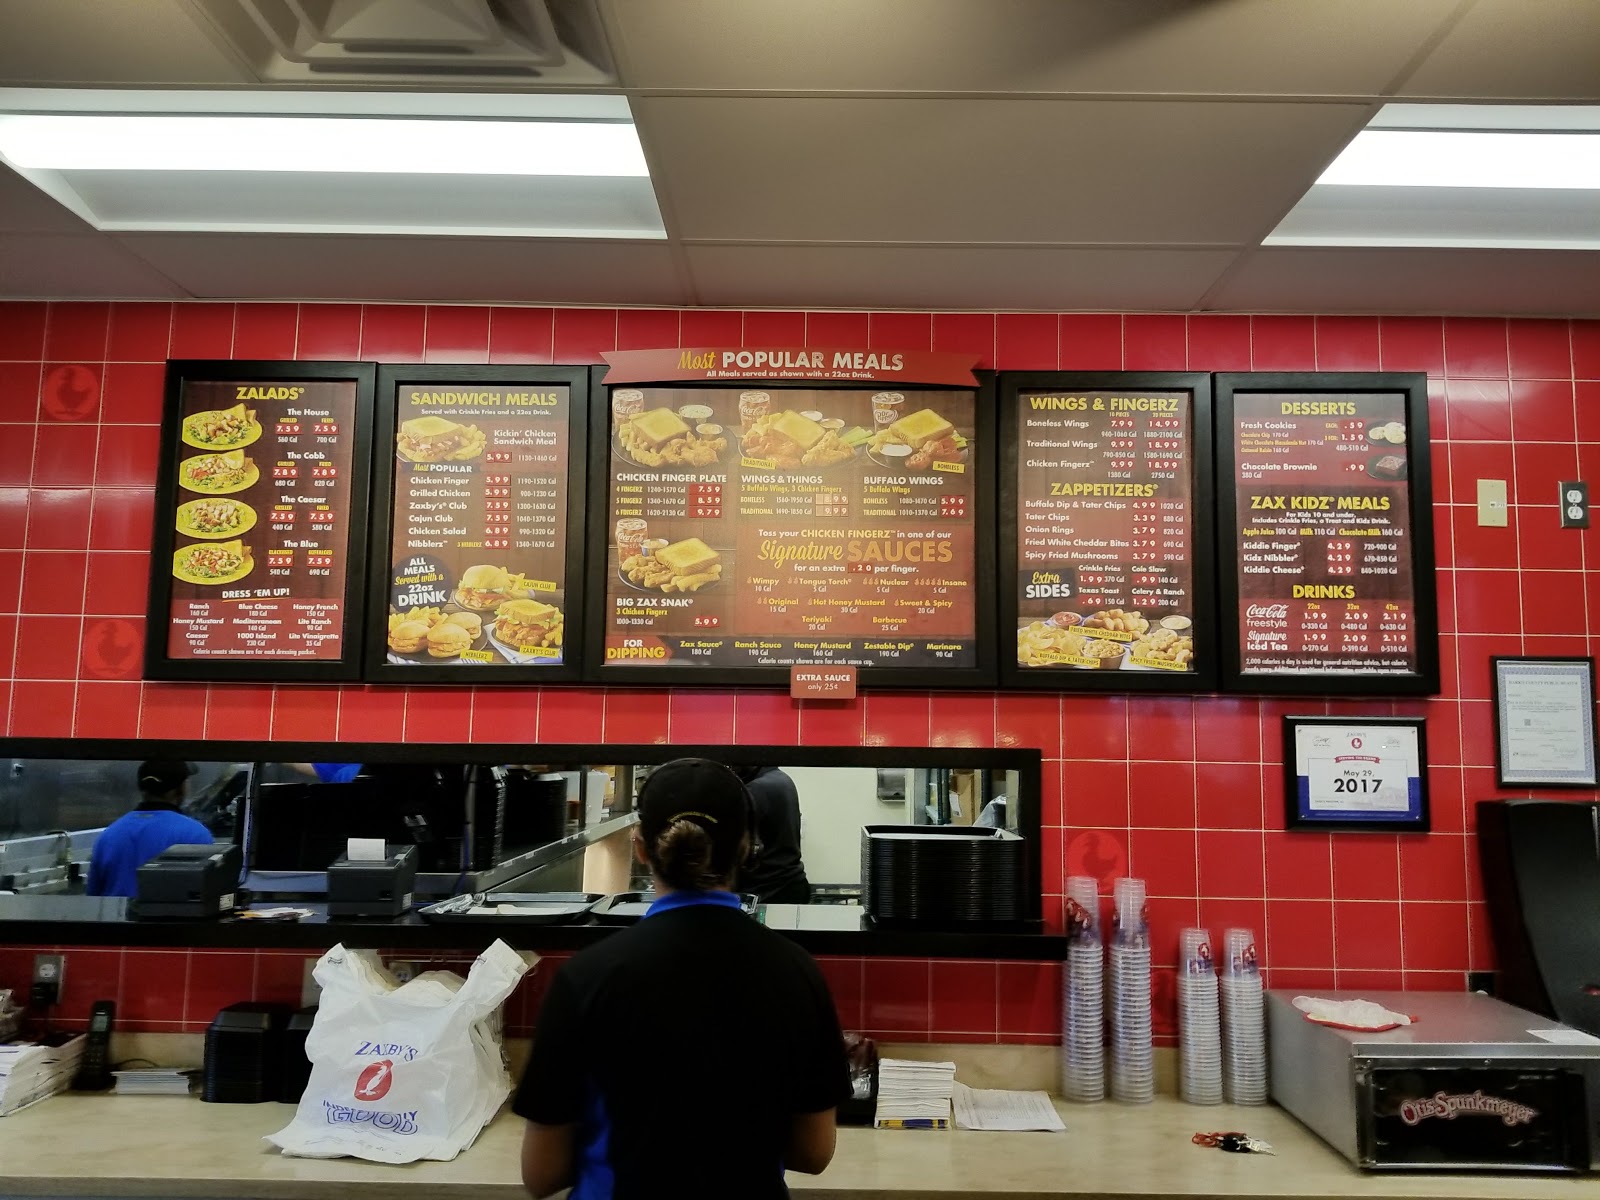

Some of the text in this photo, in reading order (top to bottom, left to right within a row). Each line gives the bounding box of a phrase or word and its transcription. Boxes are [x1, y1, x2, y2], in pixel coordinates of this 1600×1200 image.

[678, 351, 904, 370] Most POPULAR MEALS
[236, 387, 299, 399] ZALADS
[411, 393, 557, 405] SANDWICH MEALS
[1030, 397, 1179, 411] WINGS & FINGERZ
[1281, 402, 1356, 415] DESSERTS
[1064, 420, 1089, 428] Wings
[1072, 441, 1097, 449] Wings
[1241, 463, 1281, 471] Chocolate
[444, 478, 469, 486] Finger
[617, 473, 659, 481] CHICKEN
[662, 474, 696, 482] FINGER
[742, 475, 776, 483] WINGS
[787, 476, 822, 484] THINGS
[864, 477, 943, 485] BUFFALO WINGS
[1051, 483, 1153, 497] ZAPPETIZERS
[410, 502, 443, 511] Zaxby's
[1057, 501, 1070, 509] Dip
[1104, 502, 1126, 510] Chips
[1251, 497, 1390, 510] ZAX KIDZ MEALS
[409, 515, 432, 523] Cajun
[1048, 514, 1070, 522] Chips
[758, 529, 777, 537] Toss
[801, 530, 844, 538] CHICKEN
[847, 530, 890, 538] FINGERZ
[1052, 527, 1074, 535] Rings
[408, 540, 443, 548] Nibblerz
[1073, 539, 1108, 547] Cheddar
[1272, 543, 1297, 551] Finger
[757, 540, 953, 568] Signature SAUCES
[1025, 552, 1046, 560] Spicy
[1071, 552, 1118, 560] Mushrooms
[409, 558, 426, 566] ALL
[404, 566, 435, 575] MEALS
[874, 566, 889, 574] per
[890, 565, 919, 574] finger.
[394, 574, 420, 585] Served
[421, 573, 437, 583] with
[1032, 572, 1061, 584] Extra
[408, 584, 433, 593] 22oz
[1026, 584, 1070, 598] SIDES
[1132, 588, 1154, 596] Celery
[1293, 585, 1355, 598] DRINKS
[222, 590, 250, 598] DRESS
[398, 590, 447, 607] DRINK
[616, 598, 634, 606] BIG
[661, 599, 688, 607] SNAK
[1247, 619, 1287, 628] freestyle
[1247, 631, 1287, 644] Signature
[1247, 642, 1288, 650] Iced Tea
[607, 647, 665, 659] DIPPING
[808, 683, 822, 691] only
[1334, 778, 1383, 793] 2017
[355, 1041, 418, 1061] ZAXBY'S
[1401, 1090, 1537, 1126] Otis Spunkmeyer
